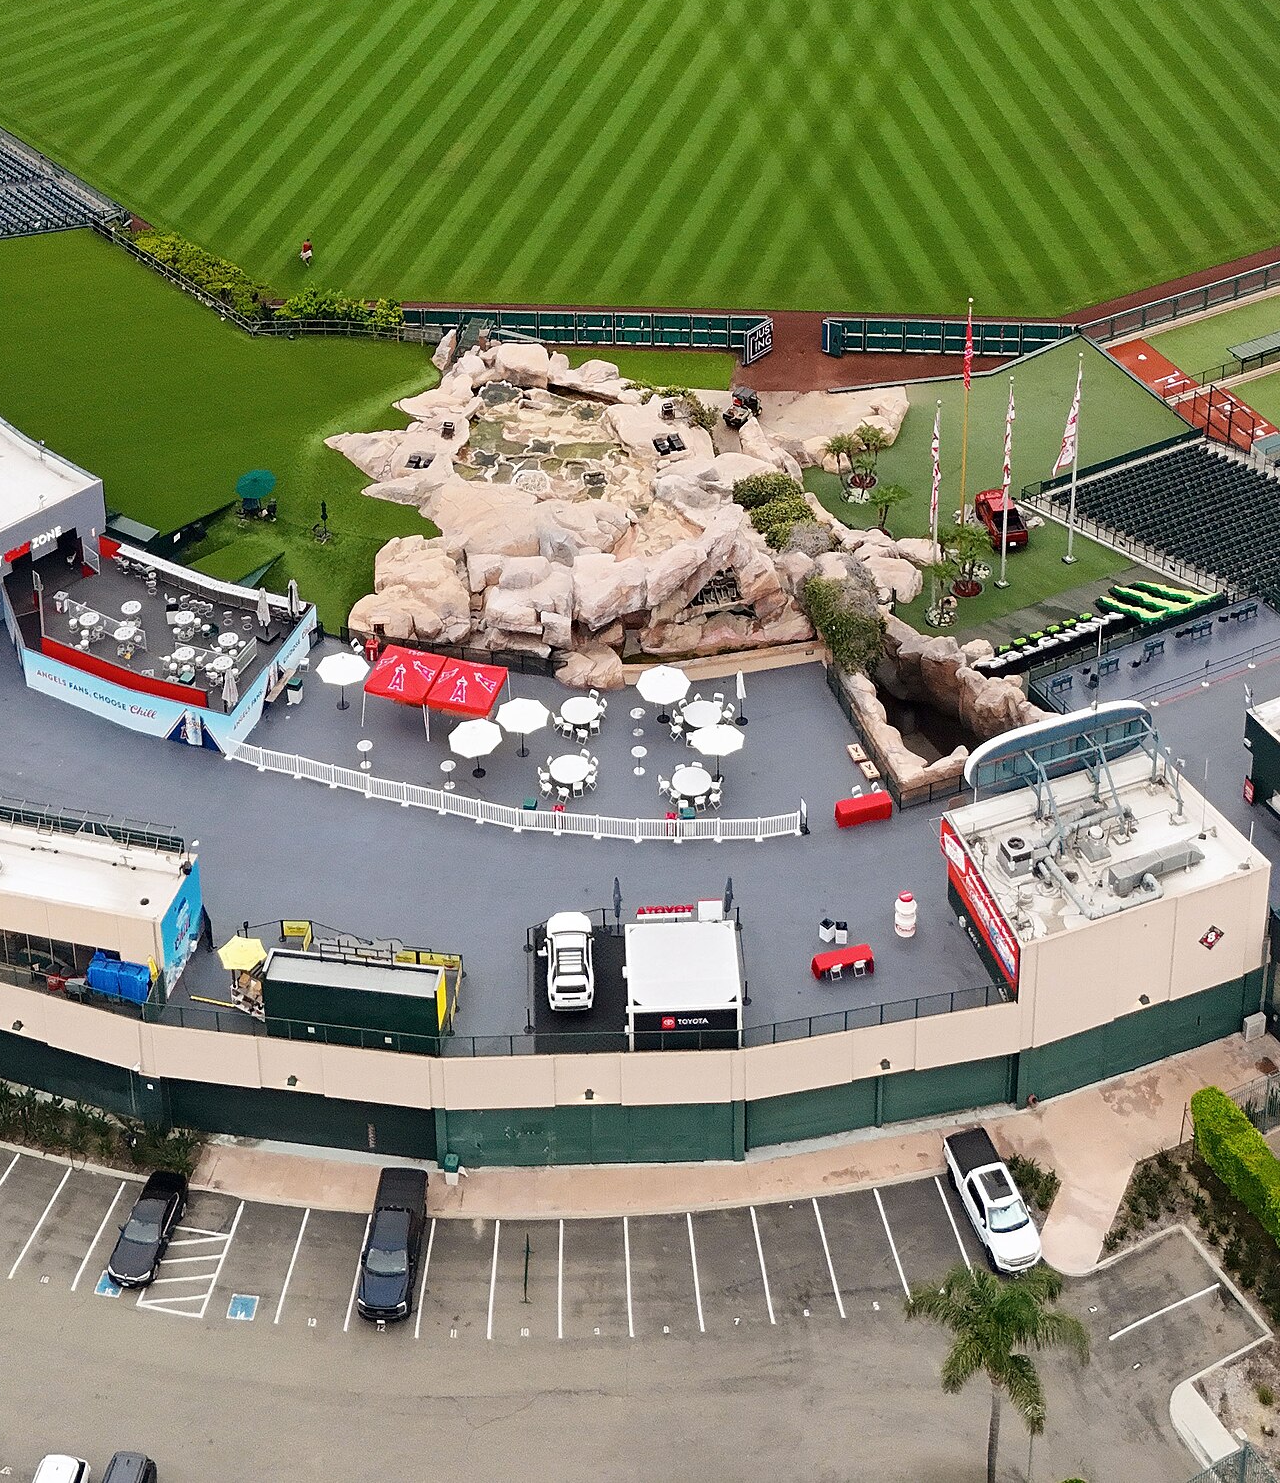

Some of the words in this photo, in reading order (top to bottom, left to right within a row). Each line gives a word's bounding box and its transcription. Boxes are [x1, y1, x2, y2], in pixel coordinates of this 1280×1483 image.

[32, 525, 63, 549] ZONE
[36, 669, 67, 687] ANGELS
[93, 692, 127, 711] CHOOSE
[128, 703, 158, 720] Chill
[677, 1017, 709, 1025] TOYOTA
[872, 1301, 880, 1311] 5
[803, 1308, 810, 1317] 6
[307, 1318, 317, 1327] 13
[376, 1324, 386, 1333] 12
[520, 1327, 529, 1337] 10
[450, 1329, 458, 1338] 11
